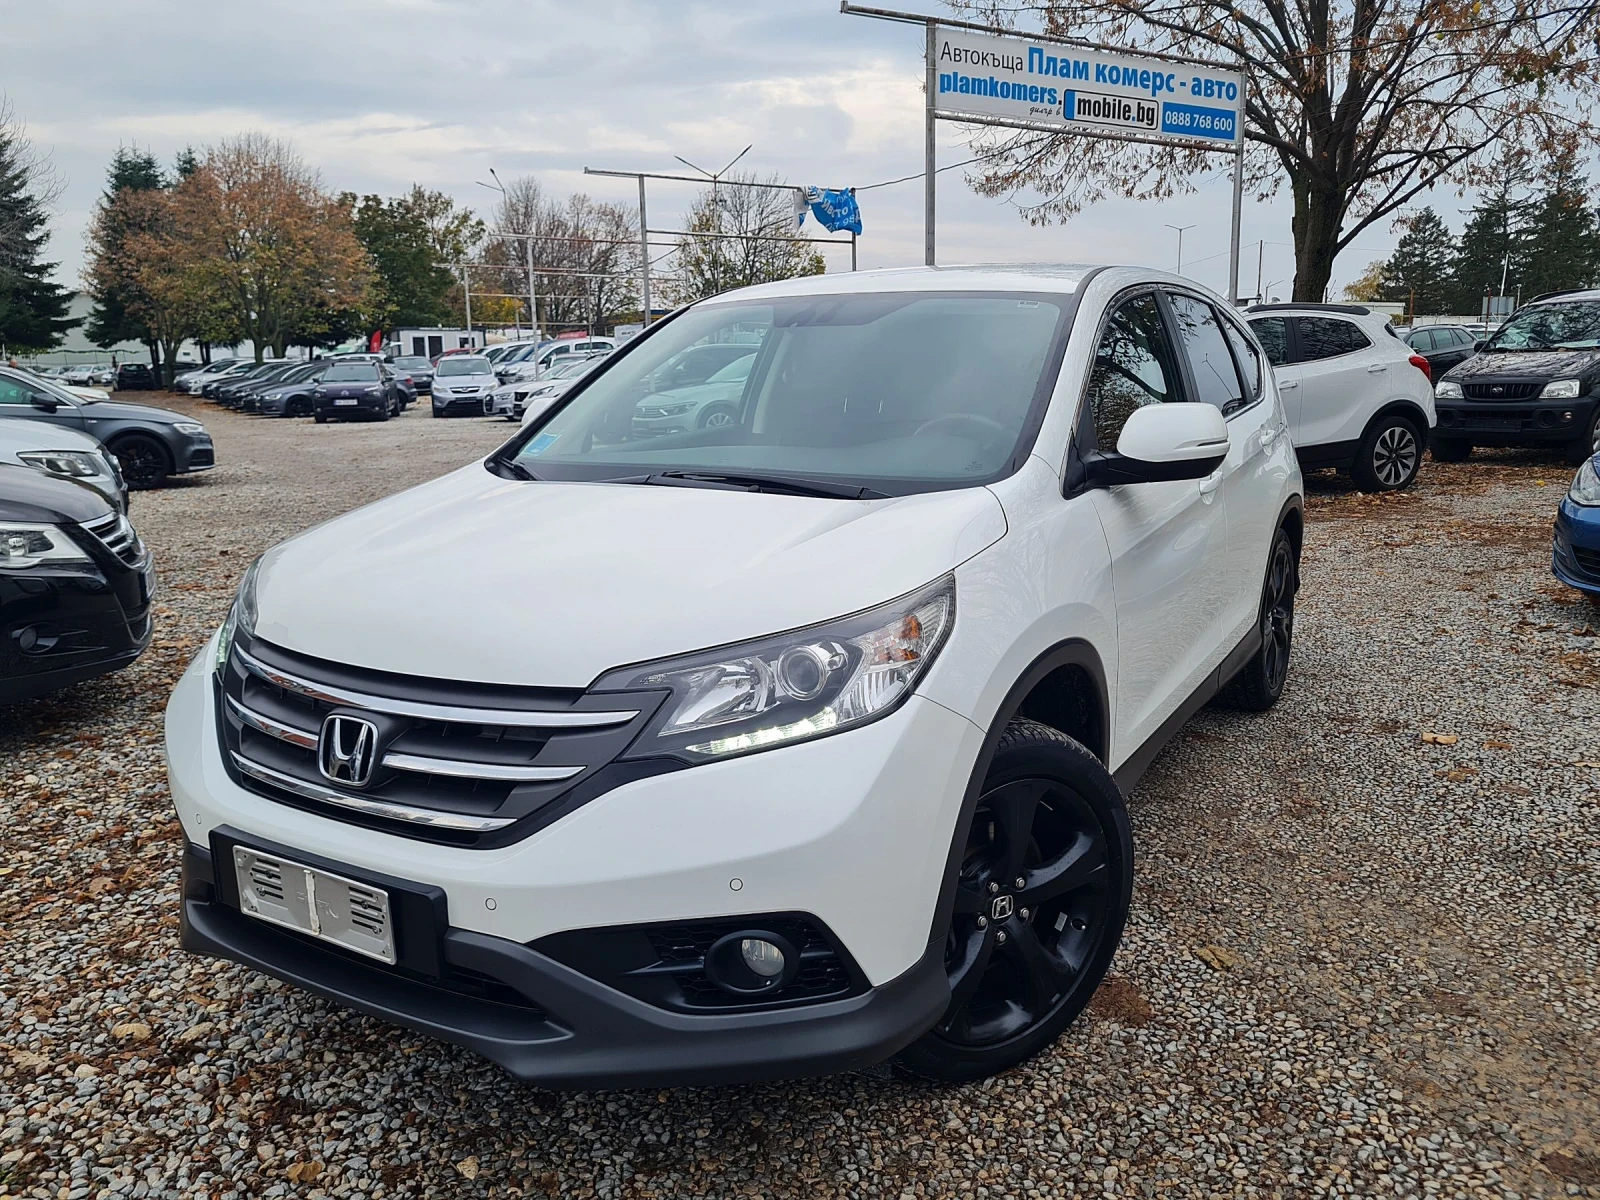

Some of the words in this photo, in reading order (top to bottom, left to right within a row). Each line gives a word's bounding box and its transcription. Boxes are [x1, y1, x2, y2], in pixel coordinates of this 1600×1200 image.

[940, 41, 1023, 74] Автокъща
[1028, 46, 1089, 81] Плам
[1095, 63, 1175, 97] комерс
[1190, 77, 1238, 101] авто
[1077, 97, 1155, 126] mobile.bg
[1165, 111, 1191, 127] 0888
[1193, 114, 1212, 129] 768
[1213, 117, 1233, 132] 600
